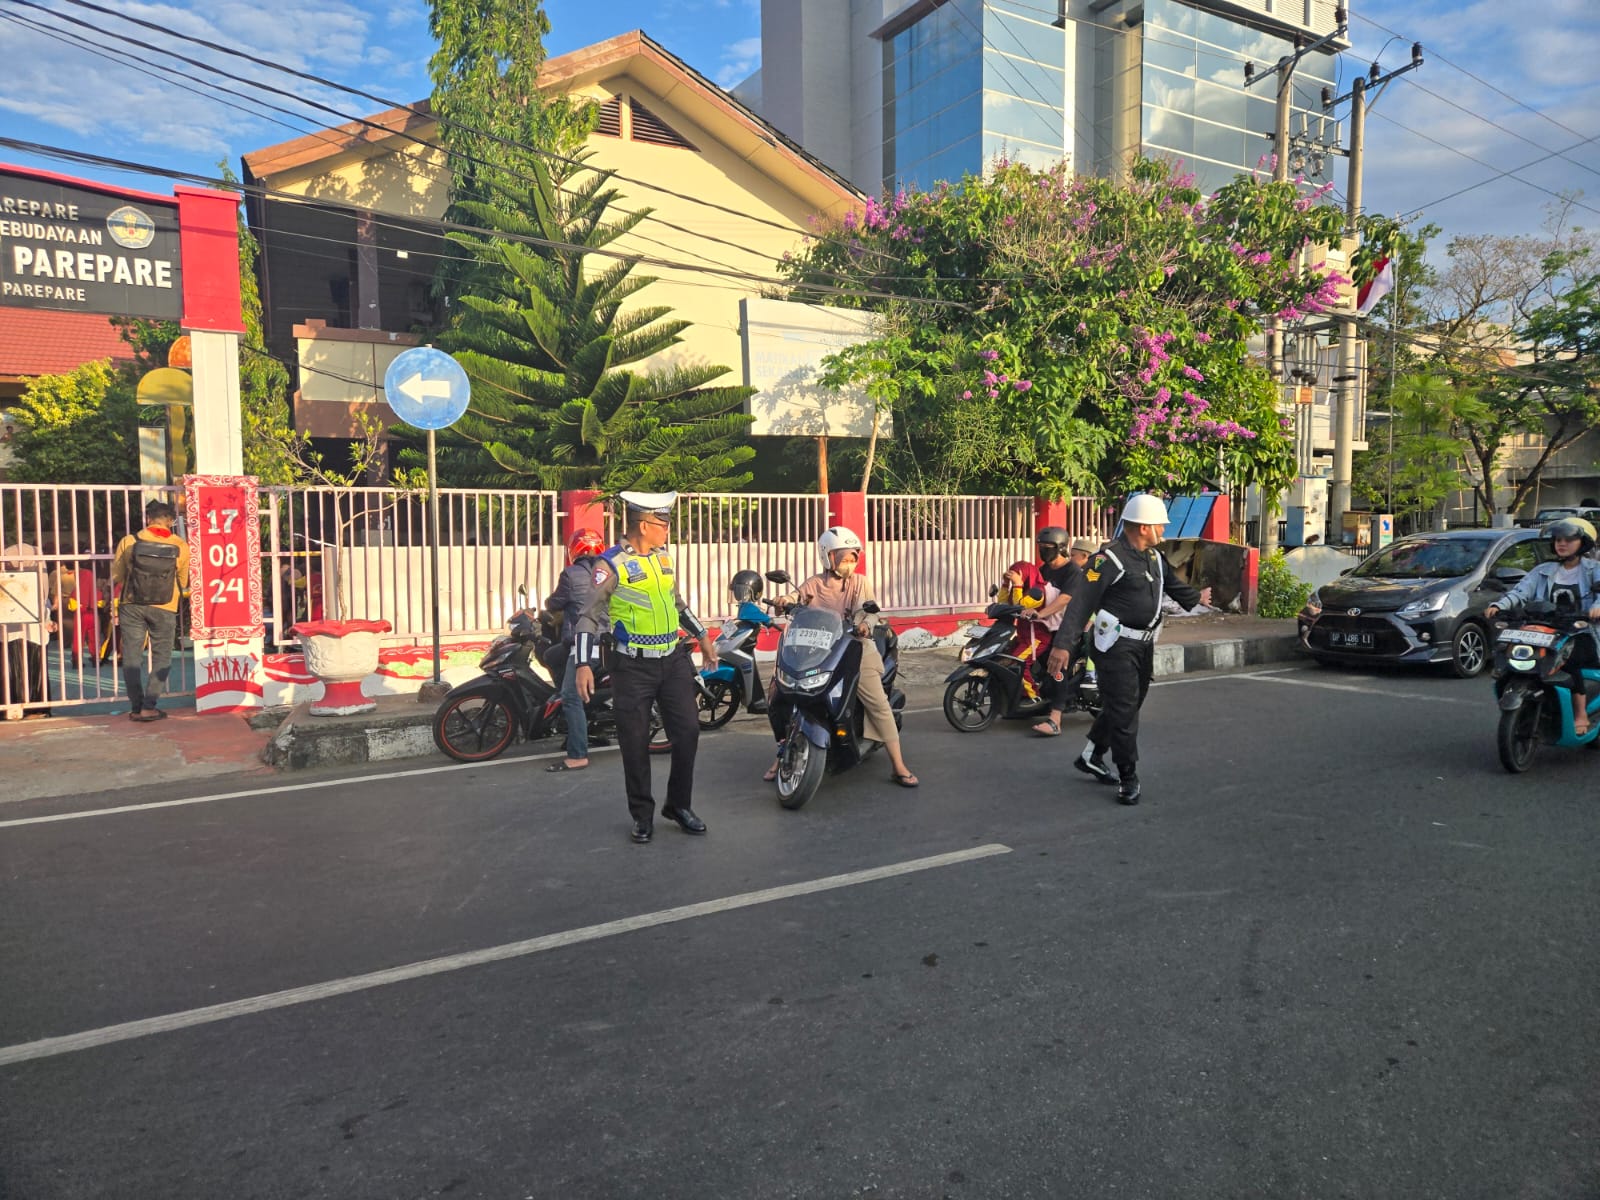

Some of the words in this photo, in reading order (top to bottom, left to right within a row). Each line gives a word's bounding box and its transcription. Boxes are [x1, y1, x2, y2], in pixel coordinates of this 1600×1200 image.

[0, 197, 79, 221] REPARE
[13, 245, 173, 288] PAREPARE
[2, 281, 87, 302] PAREPARE
[206, 509, 239, 534] 17
[208, 543, 239, 567] 08
[208, 578, 245, 603] 24
